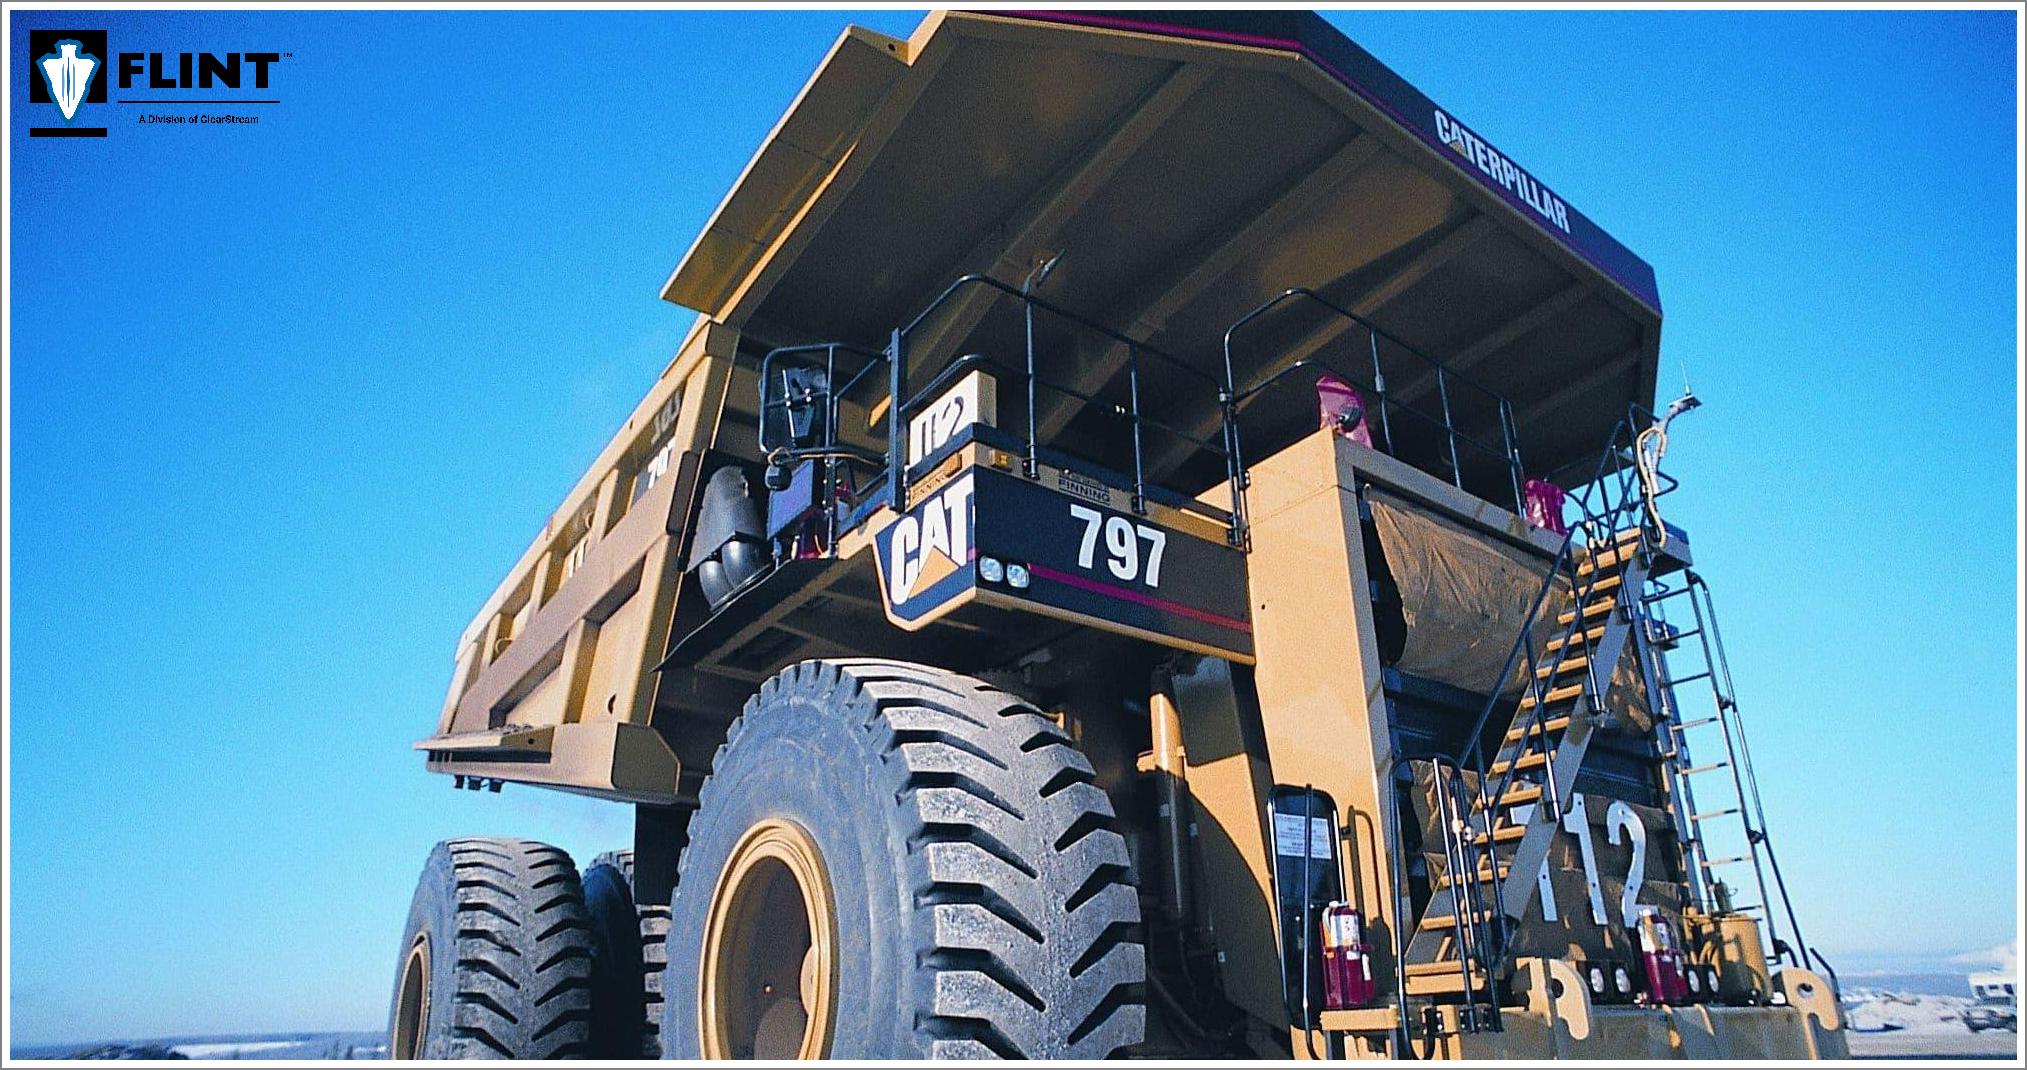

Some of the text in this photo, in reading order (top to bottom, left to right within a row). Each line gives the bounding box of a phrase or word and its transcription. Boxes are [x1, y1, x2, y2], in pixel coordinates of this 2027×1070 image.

[1434, 109, 1571, 234] CATERPILLAR
[890, 473, 975, 605] CAT
[1070, 504, 1166, 588] 797
